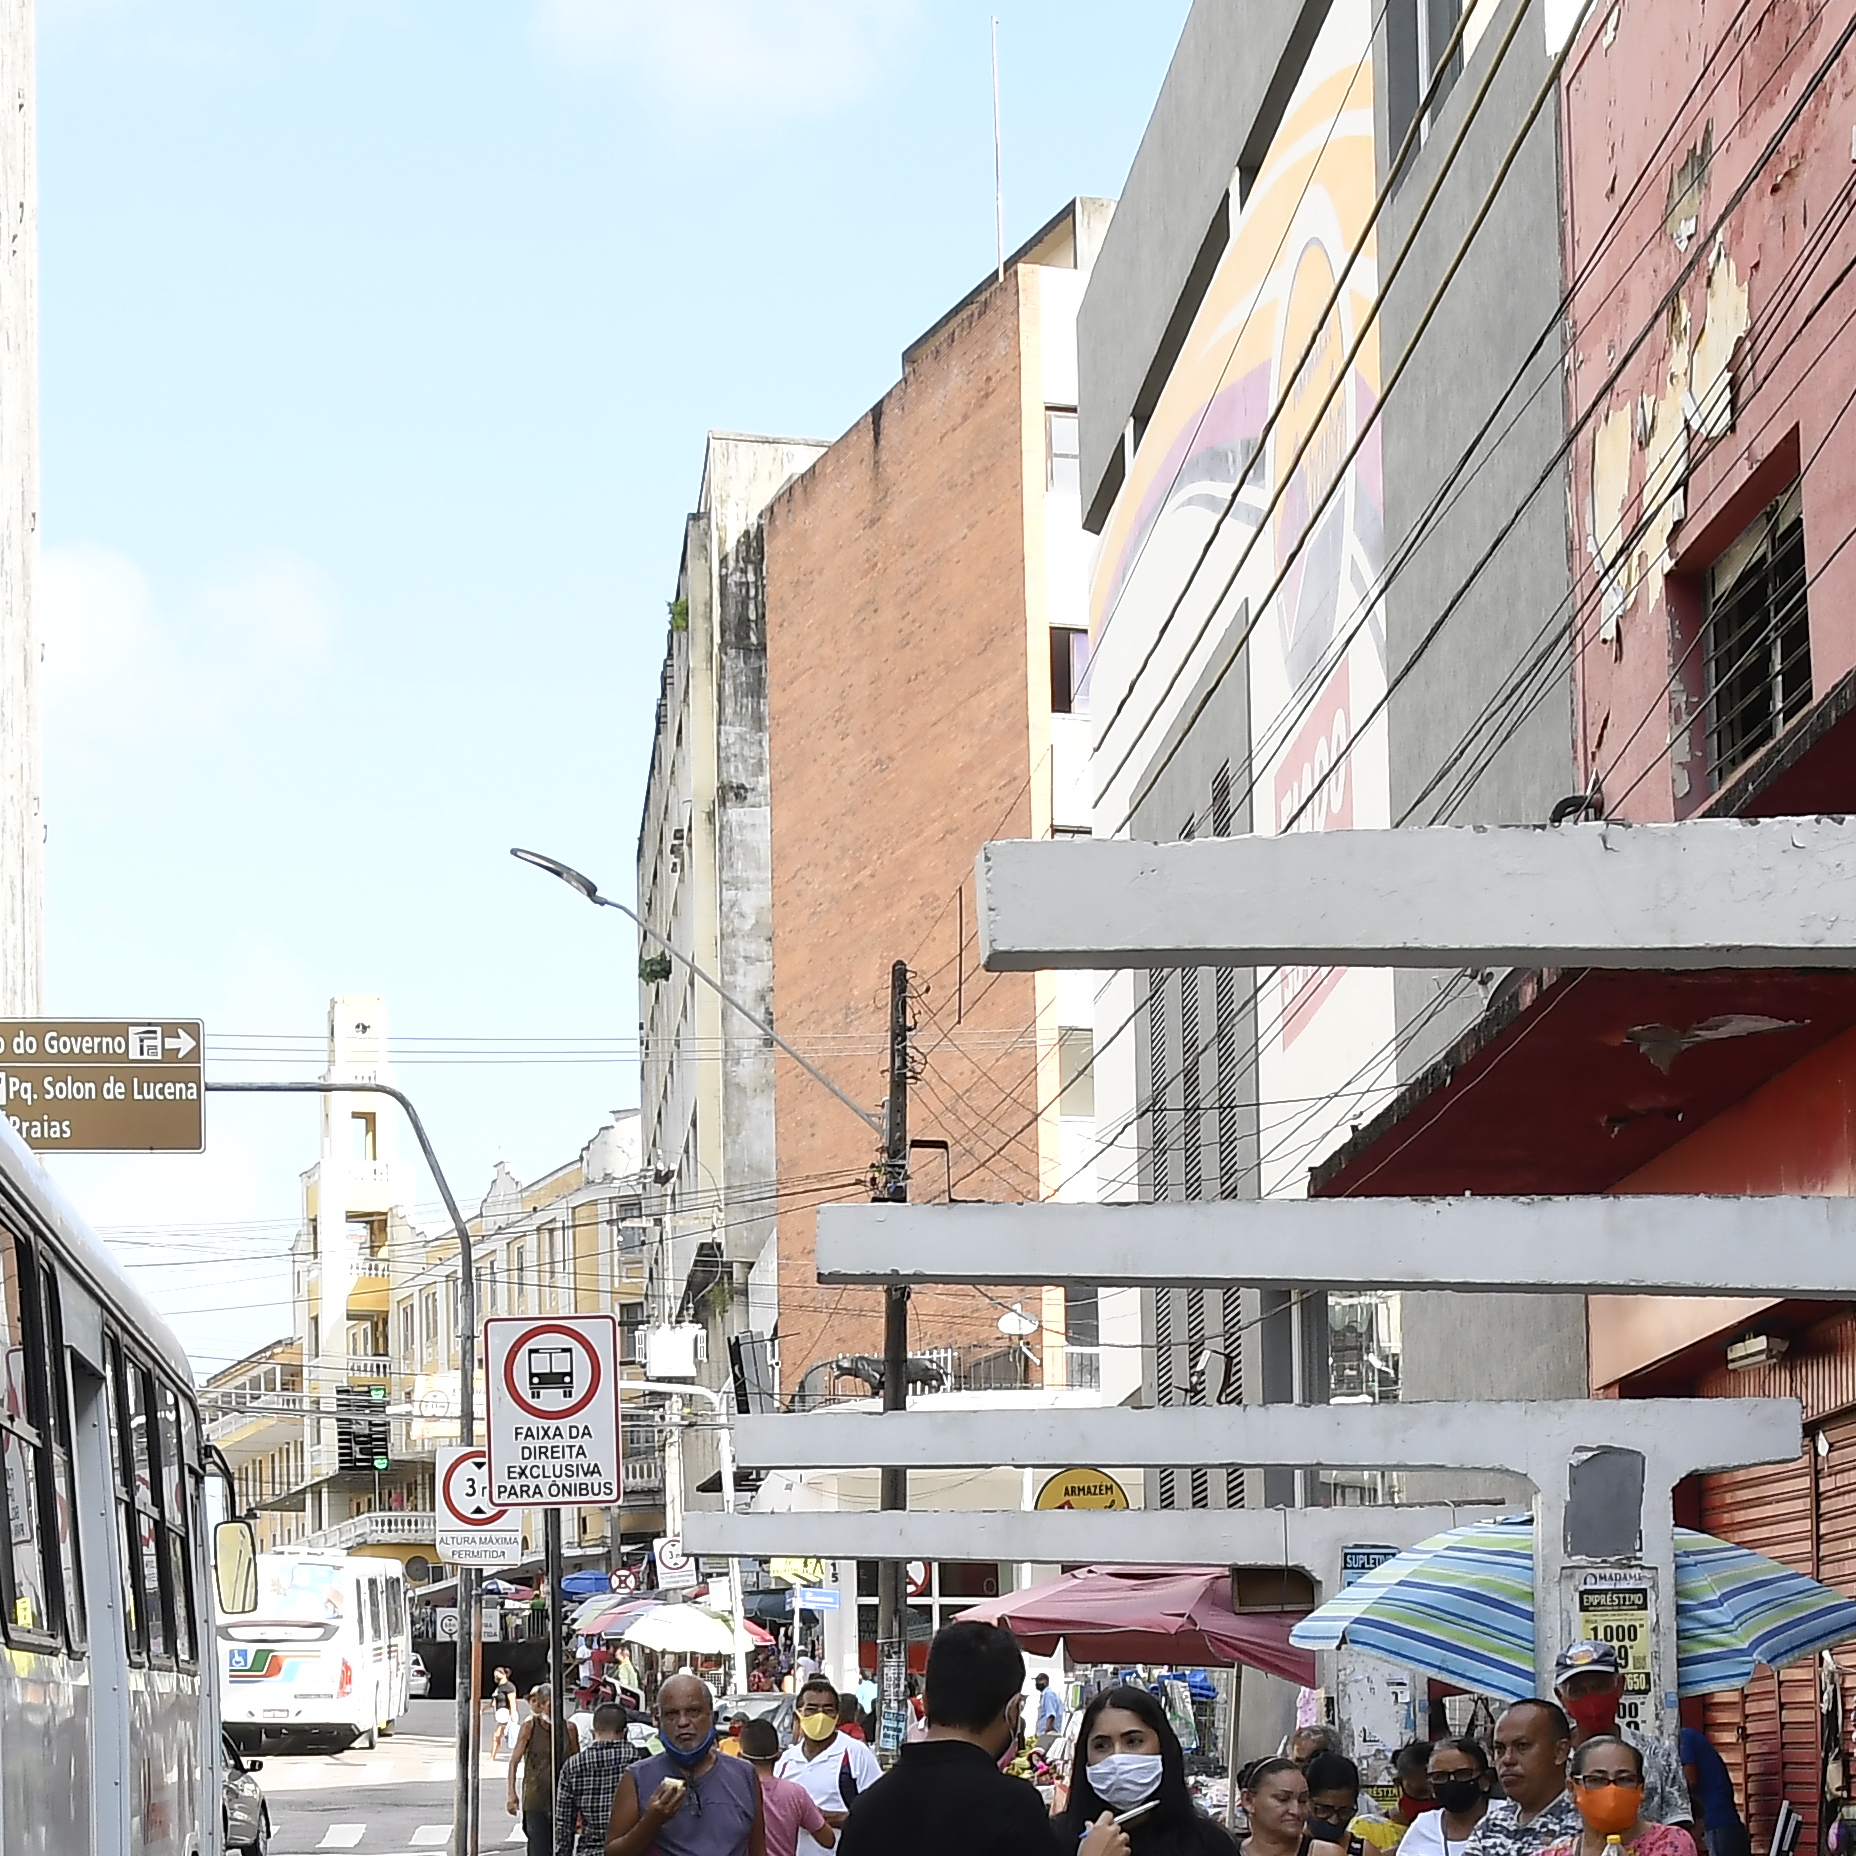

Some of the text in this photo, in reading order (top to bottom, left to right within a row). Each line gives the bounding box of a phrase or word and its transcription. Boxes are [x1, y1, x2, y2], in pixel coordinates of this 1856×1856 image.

[12, 1029, 38, 1055] do
[43, 1030, 126, 1055] Governo
[8, 1075, 198, 1105] Pq. Solon de Lucena
[514, 1424, 593, 1441] FAIXA DA
[521, 1444, 588, 1460] DIREITA
[506, 1462, 603, 1480] EXCLUSIVA
[464, 1477, 477, 1498] 3
[497, 1484, 544, 1499] PARA
[548, 1480, 614, 1498] ÔNIBUS
[1063, 1481, 1114, 1497] ARMAZÉM
[439, 1535, 520, 1546] ALTURA MÁXIMA
[451, 1549, 506, 1560] PERMITIDA
[1583, 1590, 1644, 1606] EMPRÉSTIMO
